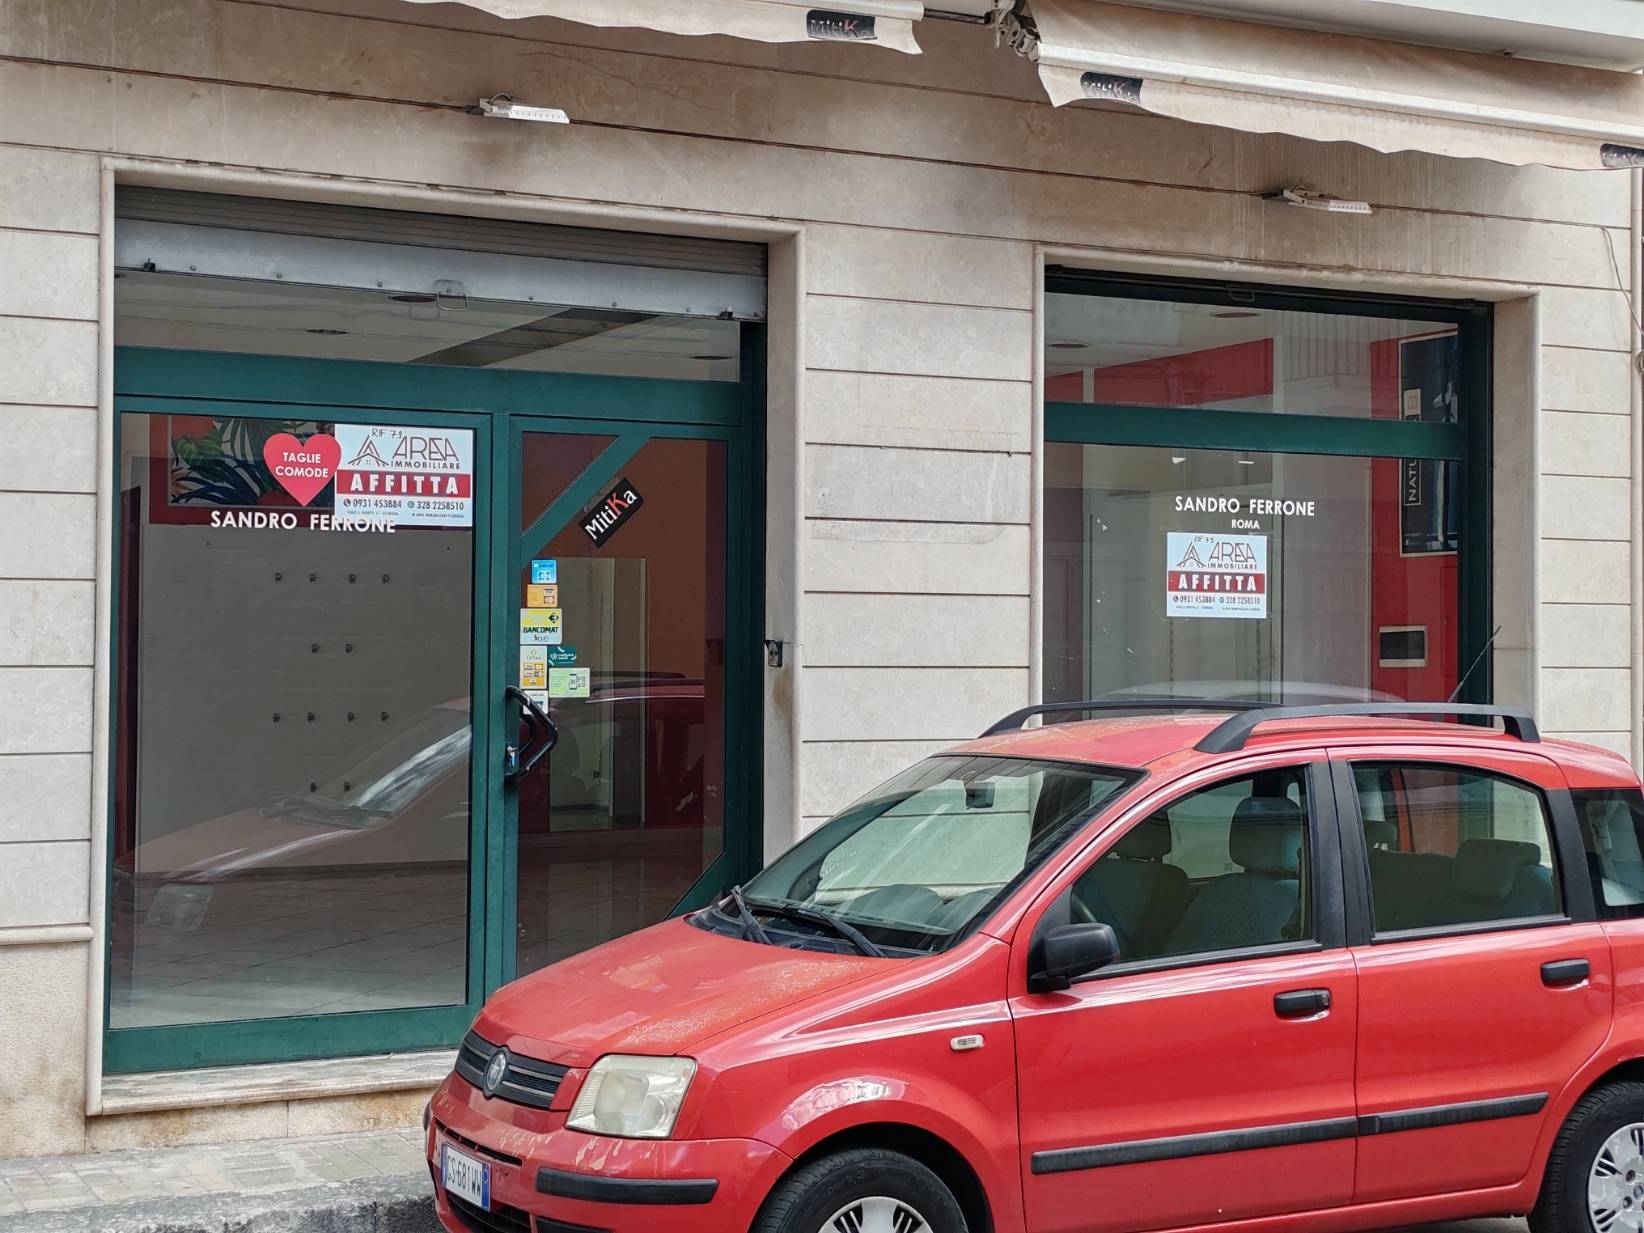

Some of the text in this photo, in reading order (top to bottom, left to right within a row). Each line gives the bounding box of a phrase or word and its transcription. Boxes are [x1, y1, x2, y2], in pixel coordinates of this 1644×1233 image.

[392, 436, 460, 461] AREA
[282, 452, 321, 464] TAGLIE
[390, 460, 461, 470] IMMOBILIARE
[275, 466, 329, 478] COMODE
[350, 473, 459, 495] AFFITTA
[353, 498, 402, 509] 0931 453884
[416, 500, 465, 511] 328 2258510
[1174, 495, 1316, 516] SANDRO FERRONE
[210, 510, 396, 533] SANDRO FERRONE
[584, 489, 637, 540] MitiKa
[1231, 519, 1260, 529] ROMA
[1208, 541, 1257, 563] AREA
[1207, 562, 1258, 570] IMMOBILIARE
[1178, 574, 1257, 592] AFFITTA
